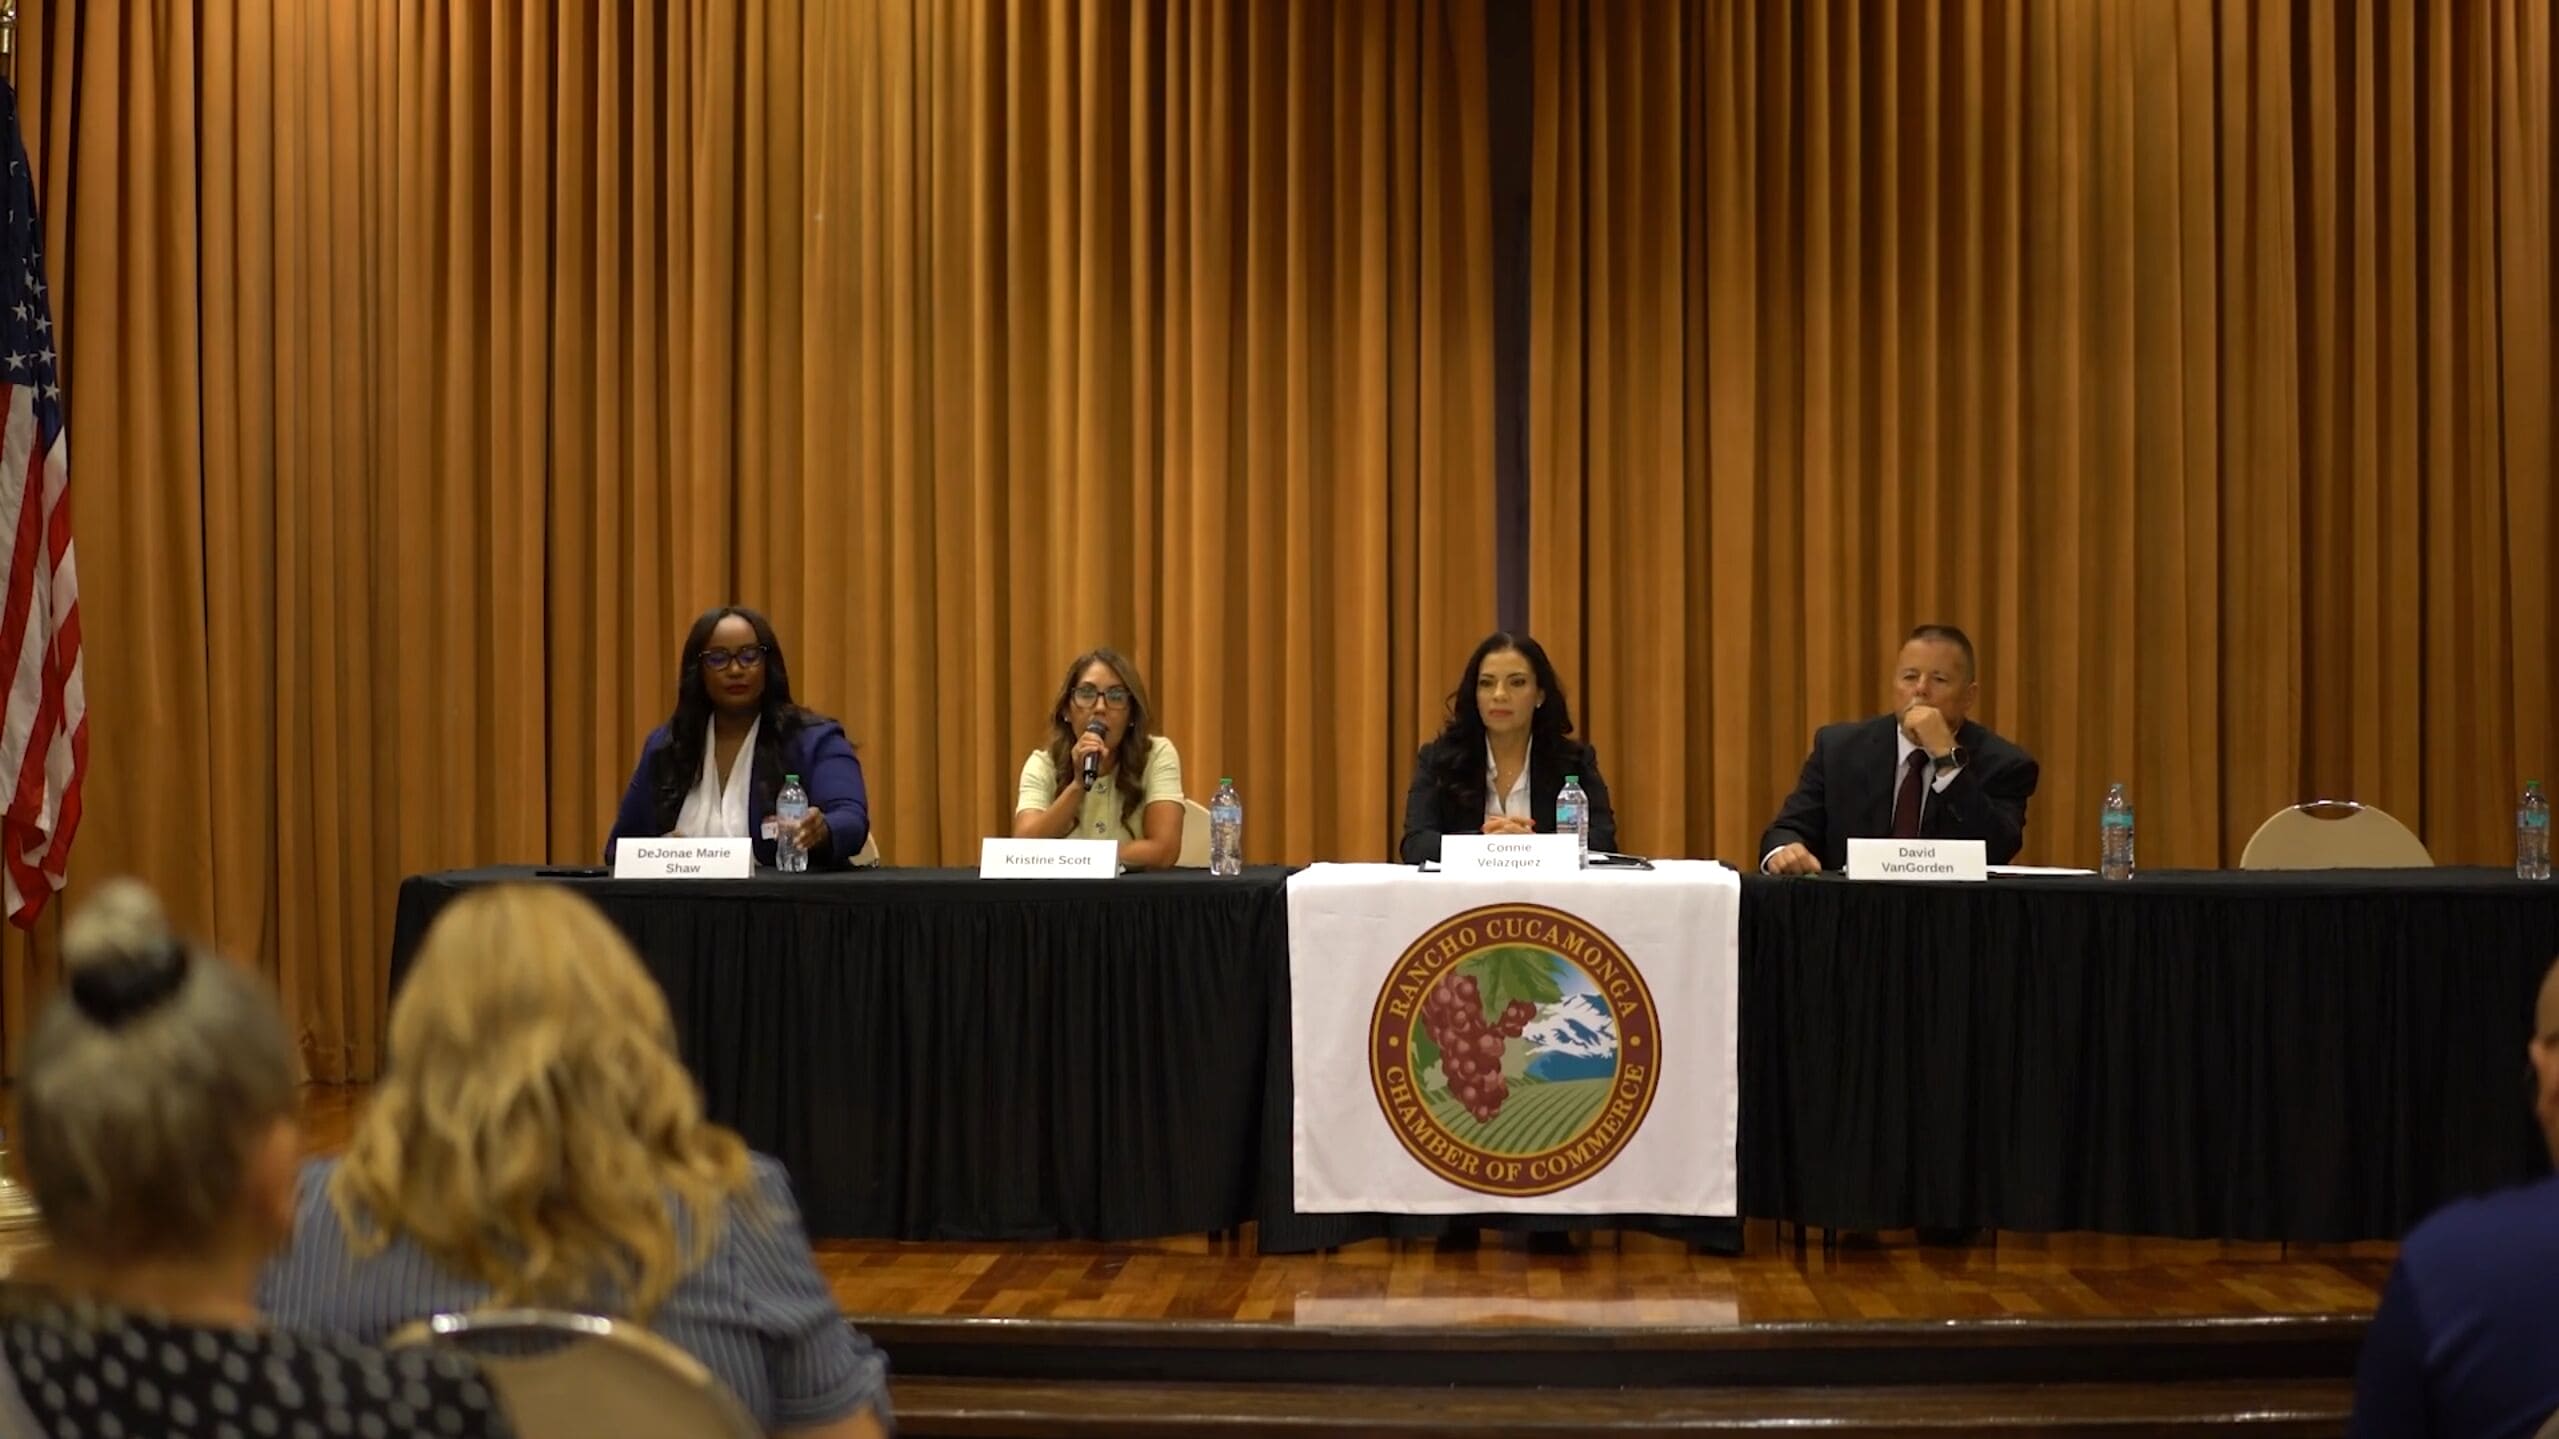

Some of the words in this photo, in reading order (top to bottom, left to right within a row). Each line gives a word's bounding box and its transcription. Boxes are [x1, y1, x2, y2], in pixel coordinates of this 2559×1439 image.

[637, 848, 693, 859] DeJonae
[696, 848, 731, 858] Marie
[1486, 843, 1532, 853] Connie
[1899, 847, 1936, 858] David
[1005, 855, 1055, 865] Kristine
[1058, 855, 1092, 865] Scott
[1477, 858, 1541, 869] Velazquez
[665, 863, 701, 873] Shaw
[1881, 862, 1954, 873] VanGorden
[1389, 927, 1477, 1019] RANCHO
[1486, 918, 1638, 1017] CUCAMONGA
[1386, 1066, 1479, 1175] CHAMBER
[1486, 1162, 1522, 1182] OF
[1530, 1064, 1645, 1180] COMMERCE
